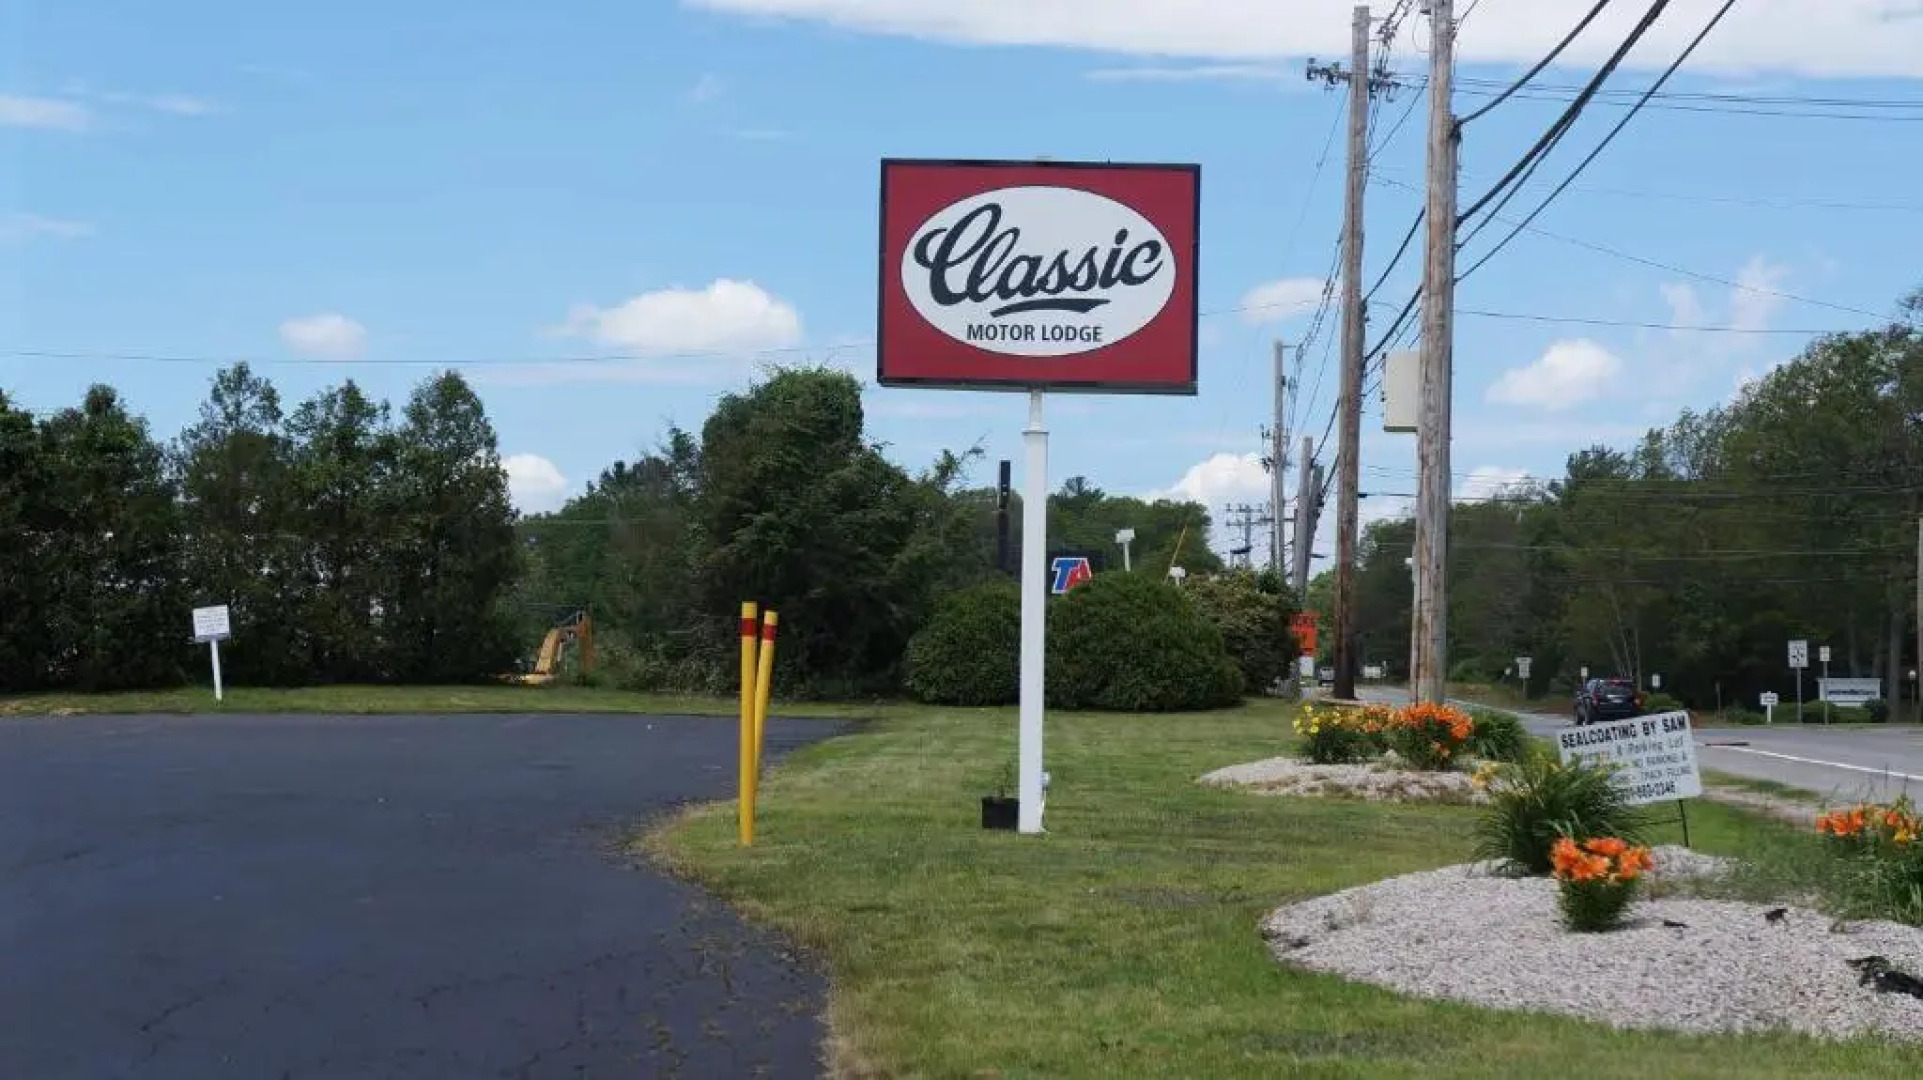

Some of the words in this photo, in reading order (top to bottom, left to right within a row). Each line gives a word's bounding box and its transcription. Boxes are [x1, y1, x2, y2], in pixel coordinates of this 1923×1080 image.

[914, 203, 1163, 306] Classic
[966, 323, 1035, 342] MOTOR
[1041, 324, 1103, 343] LODGE
[1052, 557, 1092, 594] TA
[1561, 723, 1637, 749] SEALCOATING
[1642, 721, 1656, 736] BY
[1662, 715, 1686, 733] SAM
